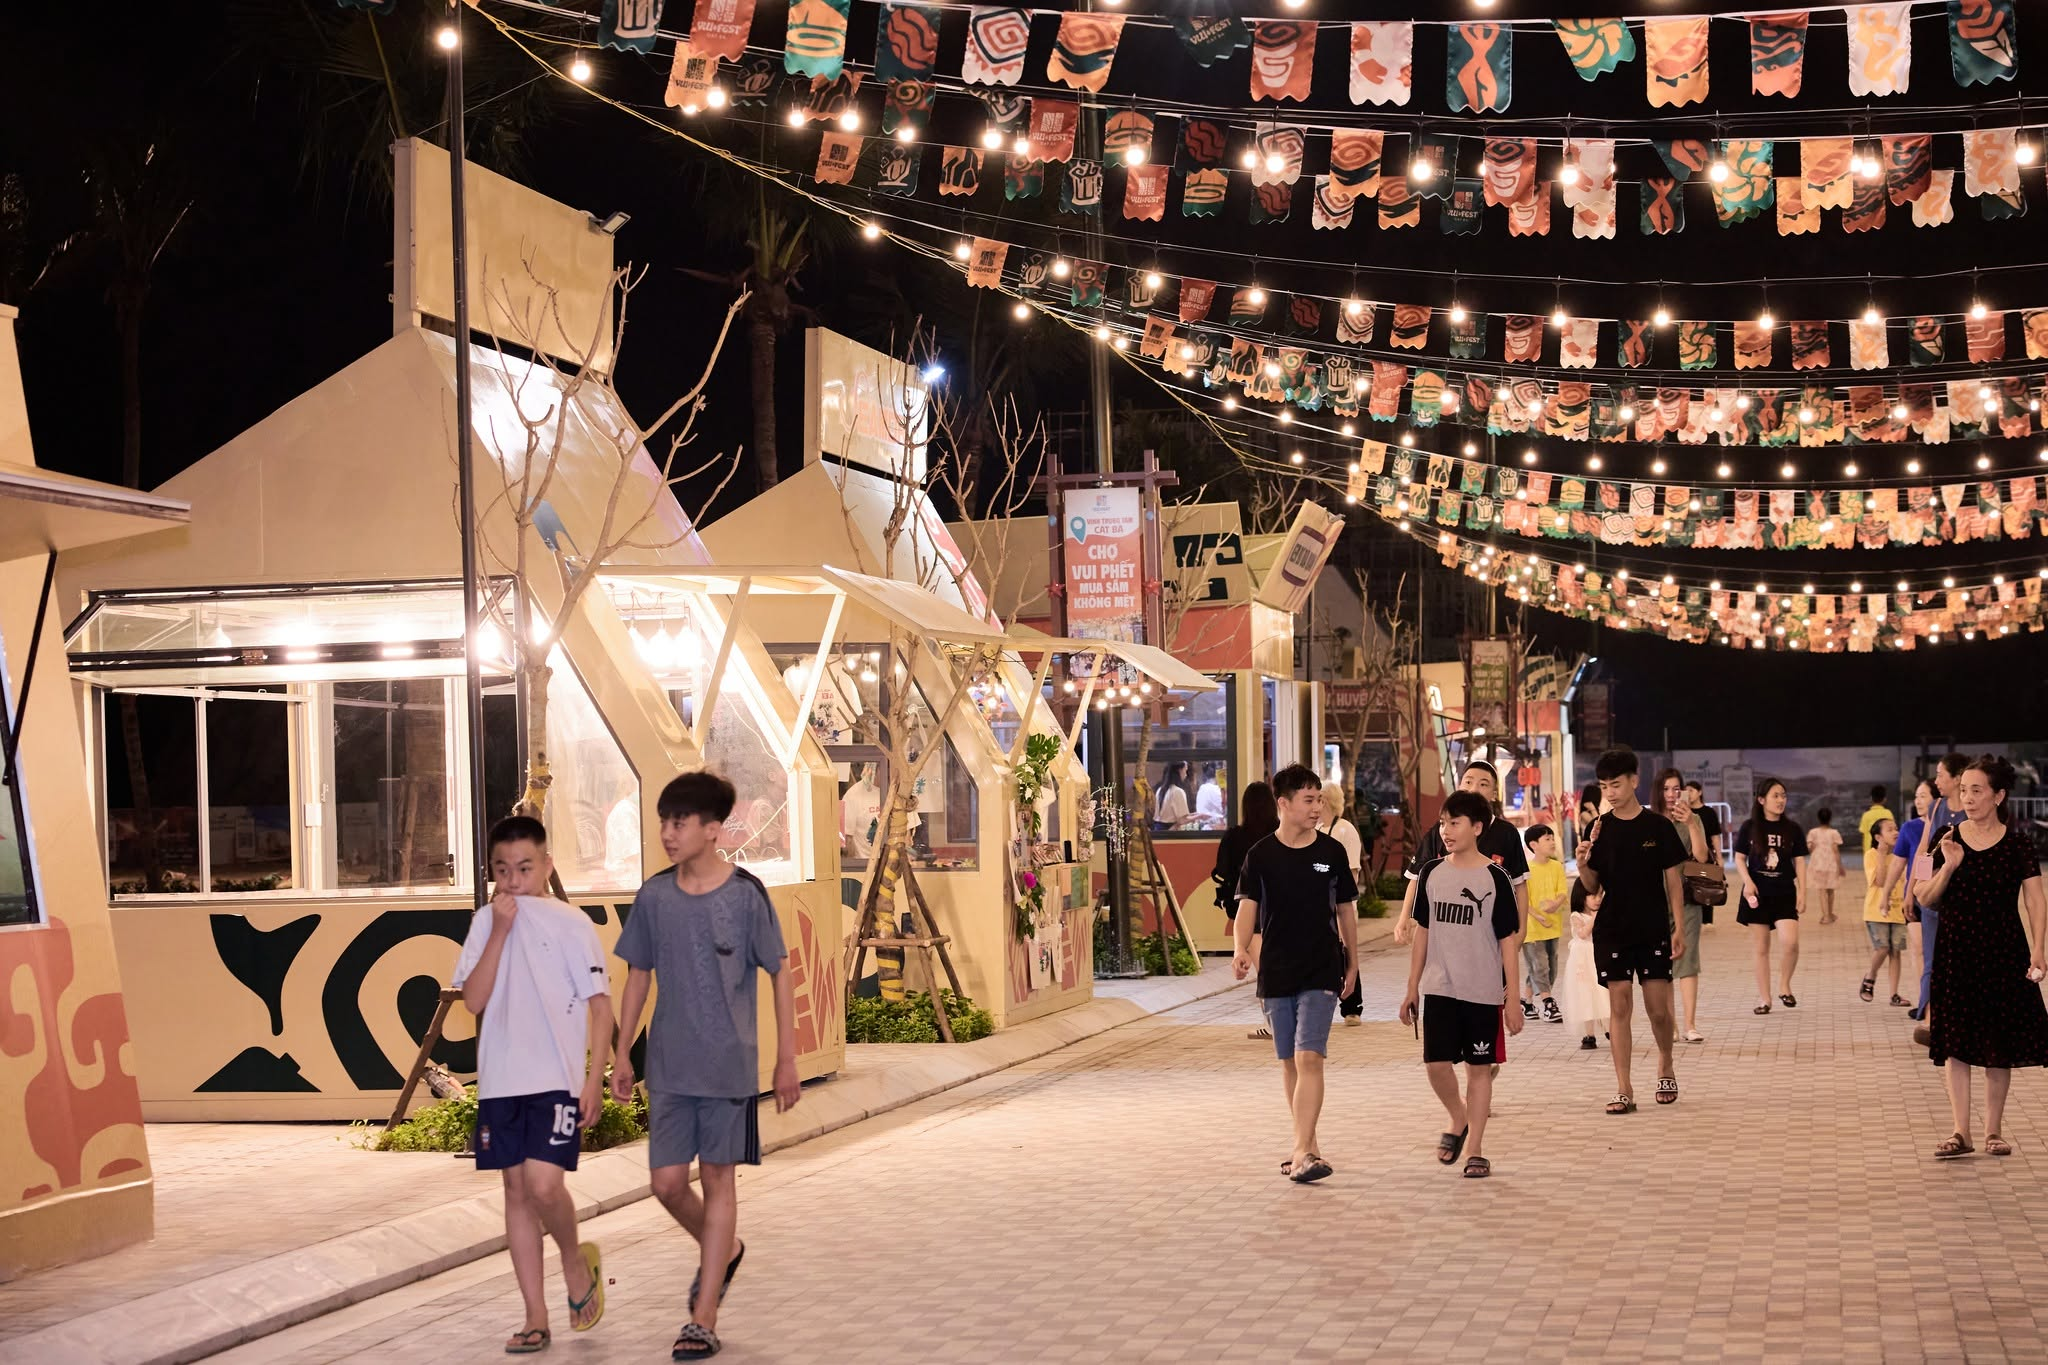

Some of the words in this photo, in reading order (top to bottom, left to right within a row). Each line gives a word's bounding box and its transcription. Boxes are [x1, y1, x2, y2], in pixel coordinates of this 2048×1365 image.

[1088, 543, 1118, 560] CHỢ
[1072, 564, 1097, 580] VUI
[1101, 559, 1135, 579] PHẾT
[1080, 582, 1104, 594] MUA
[1074, 595, 1111, 609] KHÔNG
[553, 1104, 577, 1137] 16
